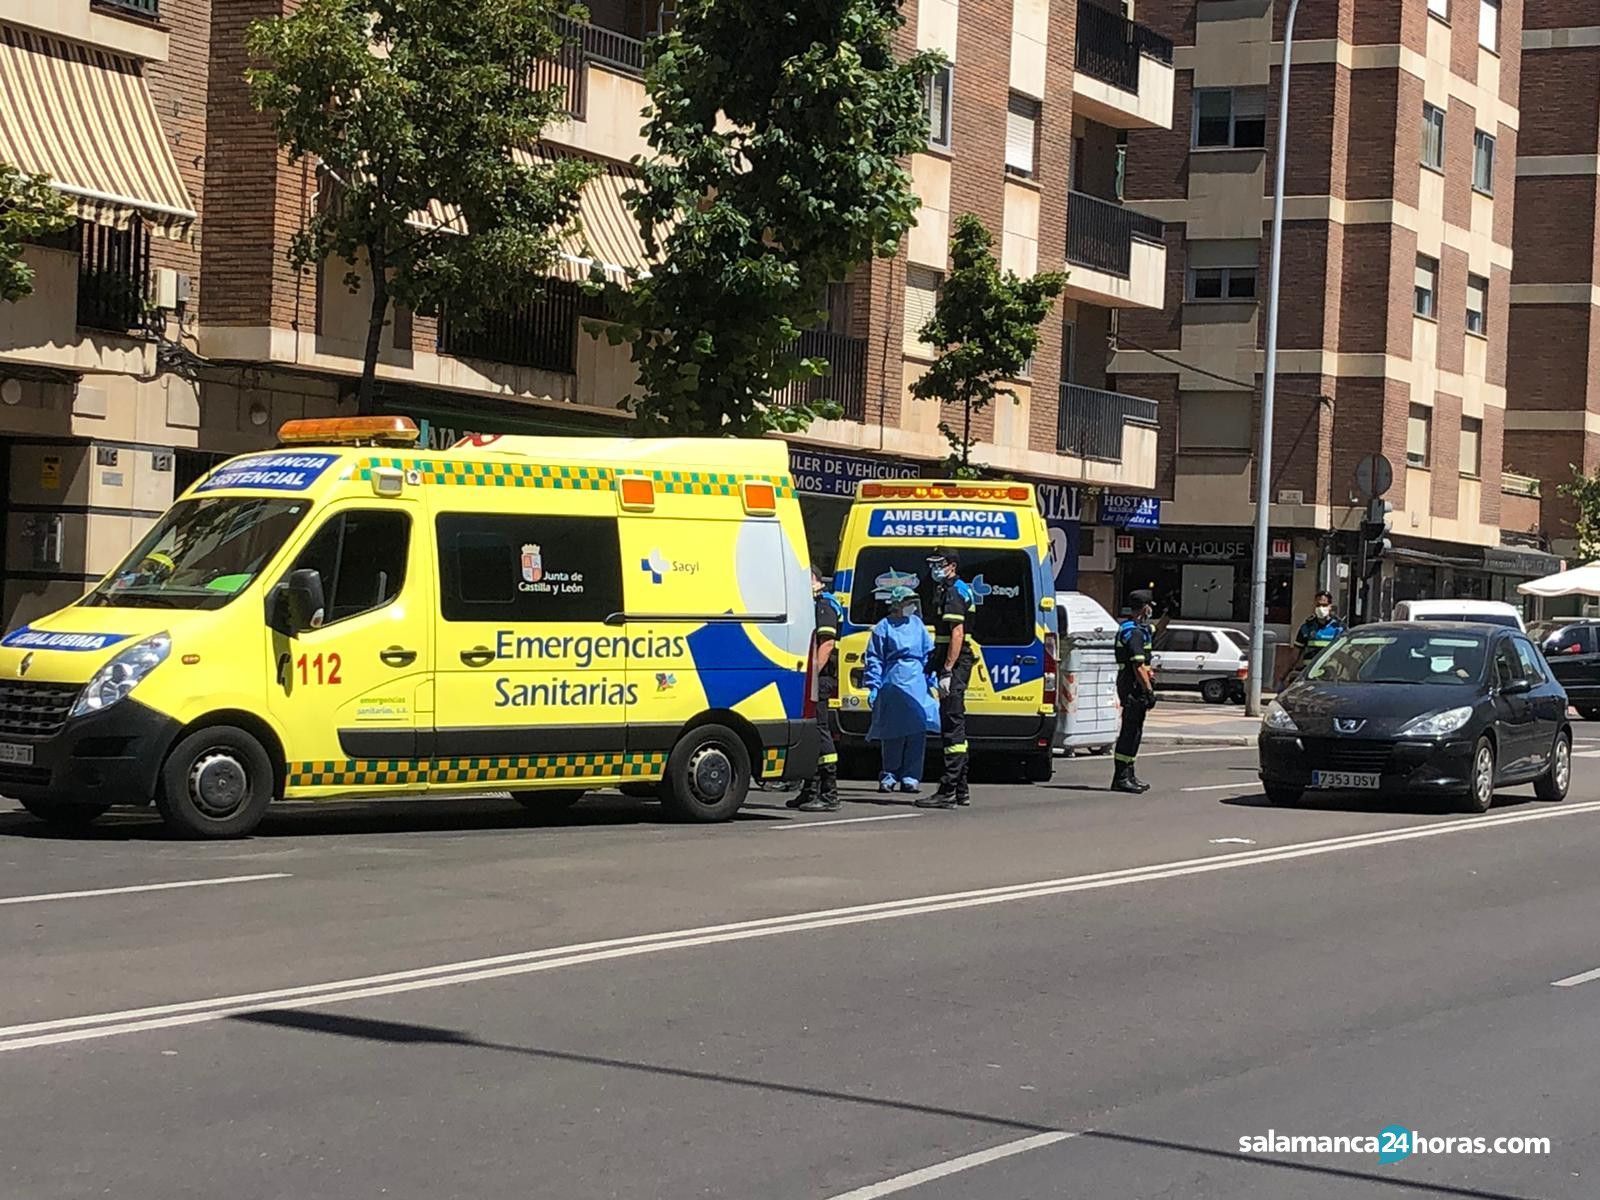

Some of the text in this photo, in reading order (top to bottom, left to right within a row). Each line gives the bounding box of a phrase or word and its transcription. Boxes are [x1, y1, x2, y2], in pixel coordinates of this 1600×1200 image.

[824, 459, 842, 475] DE
[1037, 484, 1081, 520] STAL
[1103, 495, 1158, 509] HOSTAL
[882, 509, 1006, 524] AMBULANCIA
[882, 524, 1006, 538] ASISTENCIAL
[672, 560, 700, 575] Sacyl
[543, 571, 583, 581] Junta de
[518, 582, 584, 595] Castilla y León
[992, 586, 1019, 598] Sacyl
[496, 630, 685, 668] Emergencias
[297, 652, 342, 685] 112
[991, 664, 1021, 684] 112
[494, 677, 639, 708] Sanitarias
[1320, 772, 1376, 787] 7353 DSV
